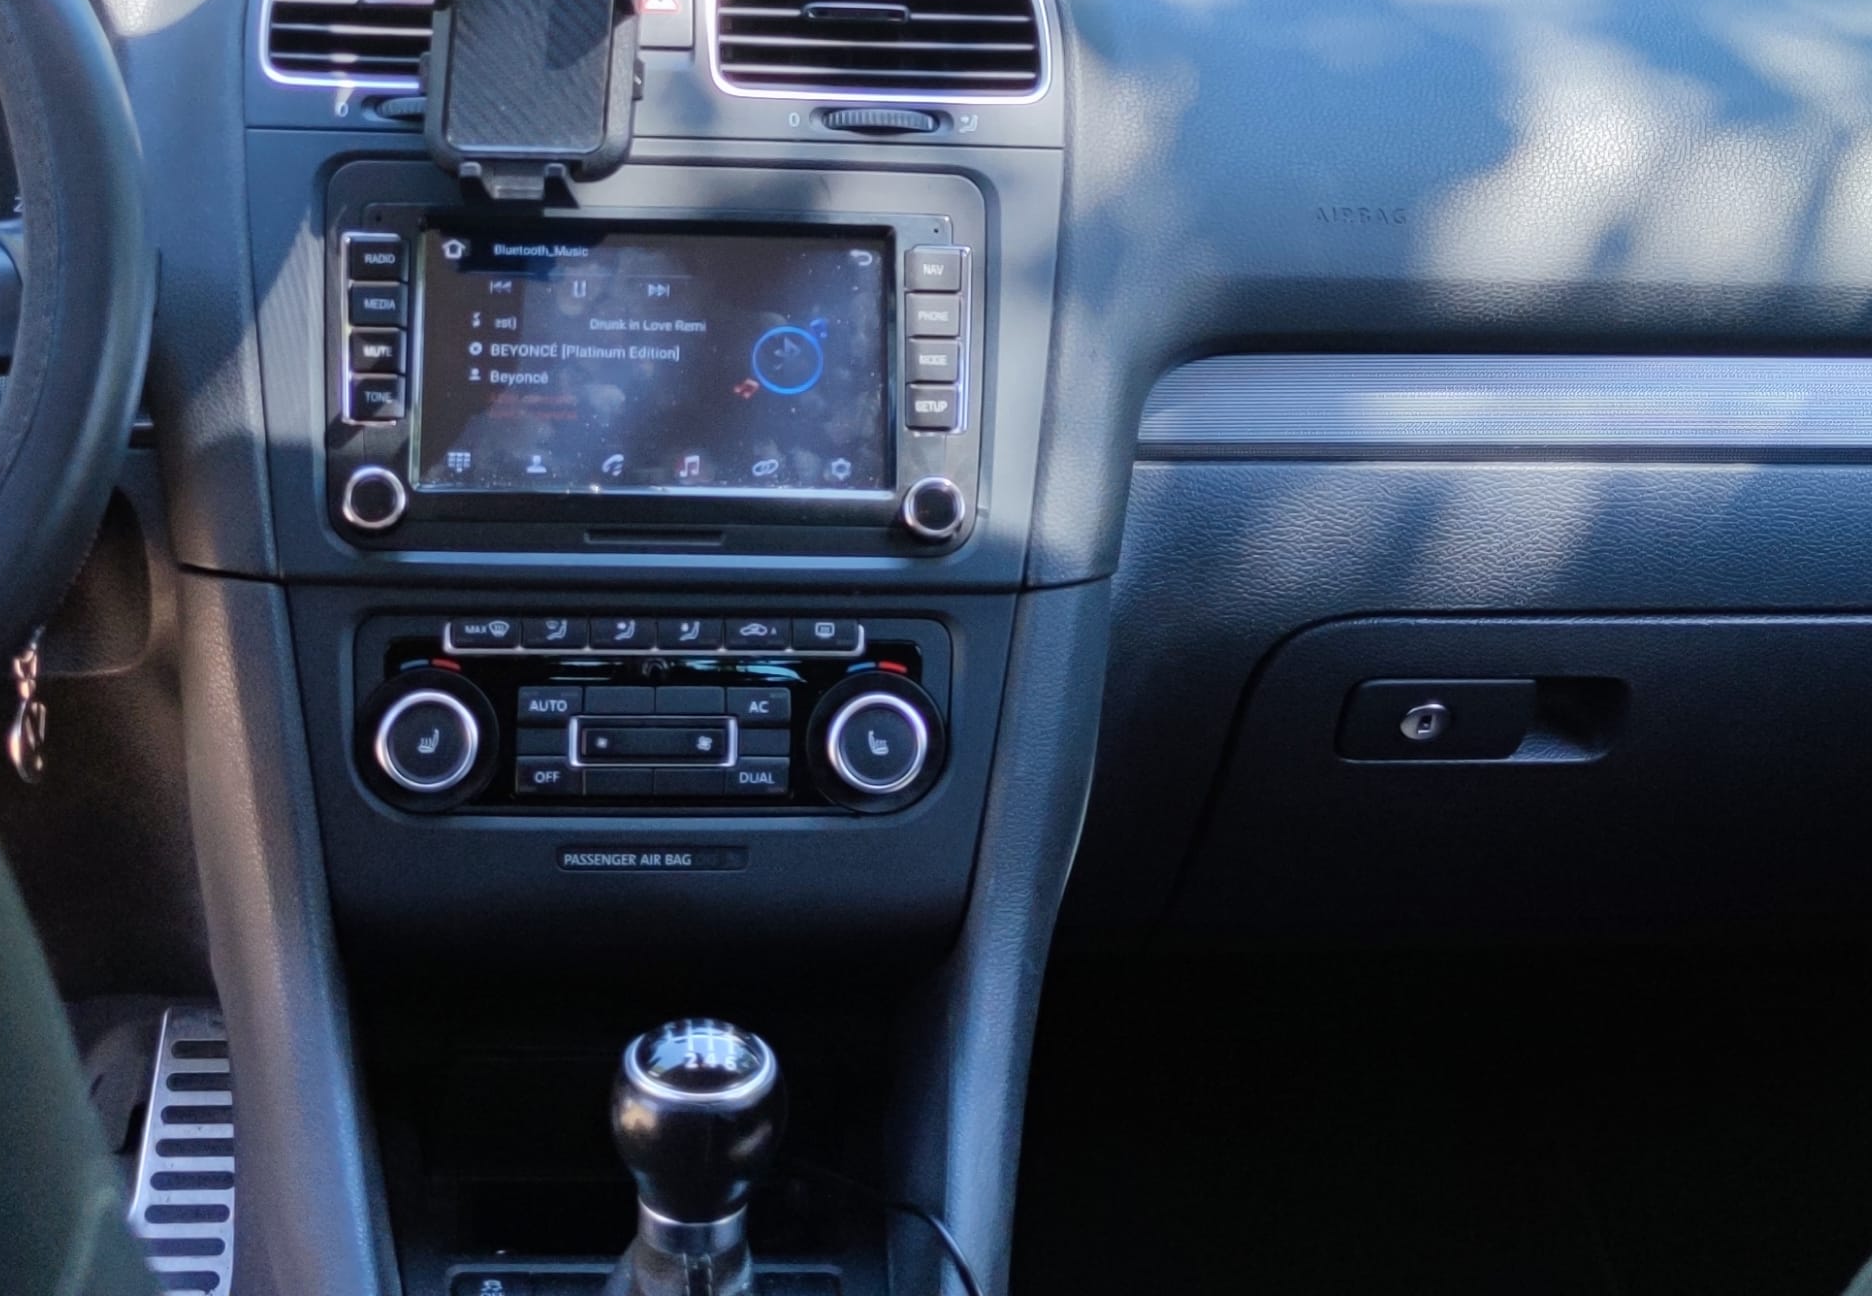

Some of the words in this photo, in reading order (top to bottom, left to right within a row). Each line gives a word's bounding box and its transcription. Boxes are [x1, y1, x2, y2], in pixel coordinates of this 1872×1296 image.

[1313, 206, 1408, 226] AIRBAG
[493, 243, 590, 257] Bluetooth_Music
[364, 253, 396, 264] RADIO
[922, 263, 944, 276] NAV
[363, 298, 396, 311] MEDIA
[917, 310, 949, 322] PHONE
[589, 317, 627, 331] Drunk
[630, 317, 640, 331] in
[643, 318, 673, 332] Love
[675, 319, 707, 333] Remi
[362, 345, 393, 358] MUTE
[490, 340, 558, 358] BEYONCÉ
[561, 343, 626, 361] [Platinum
[629, 345, 681, 362] Edition]
[489, 368, 549, 387] Beyoncé
[364, 391, 393, 404] TONE
[914, 400, 948, 414] SETUP
[464, 625, 488, 635] MAX
[529, 700, 568, 713] AUTO
[748, 700, 770, 714] AC
[533, 770, 561, 784] OFF
[739, 770, 776, 784] DUAL
[563, 853, 637, 866] PASSENGER
[640, 854, 662, 866] AIR
[664, 854, 692, 867] BAG
